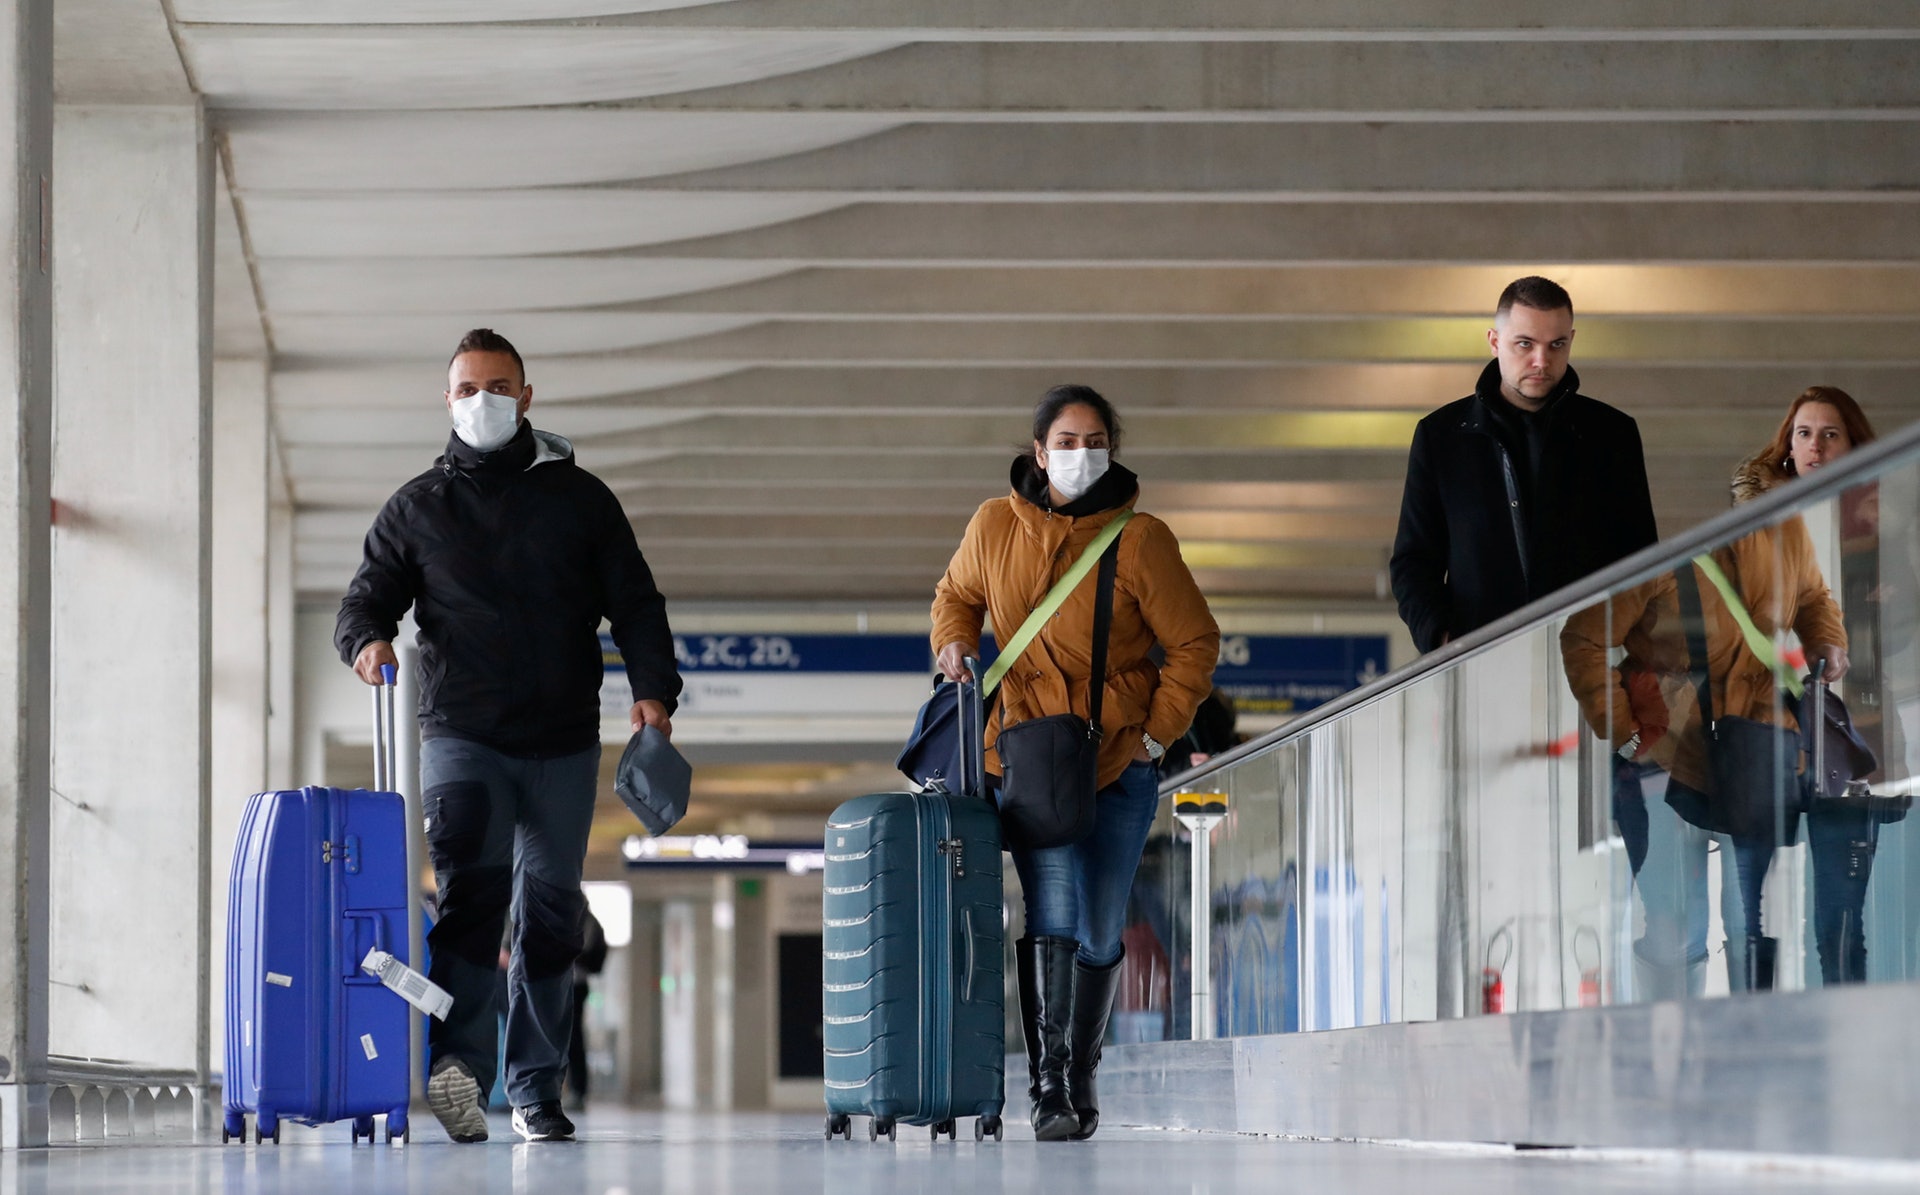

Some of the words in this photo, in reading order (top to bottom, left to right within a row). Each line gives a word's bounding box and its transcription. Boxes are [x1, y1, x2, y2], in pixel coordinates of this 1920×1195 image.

[701, 636, 747, 668] 2C,
[749, 636, 800, 668] 2D,
[377, 955, 393, 973] CDG
